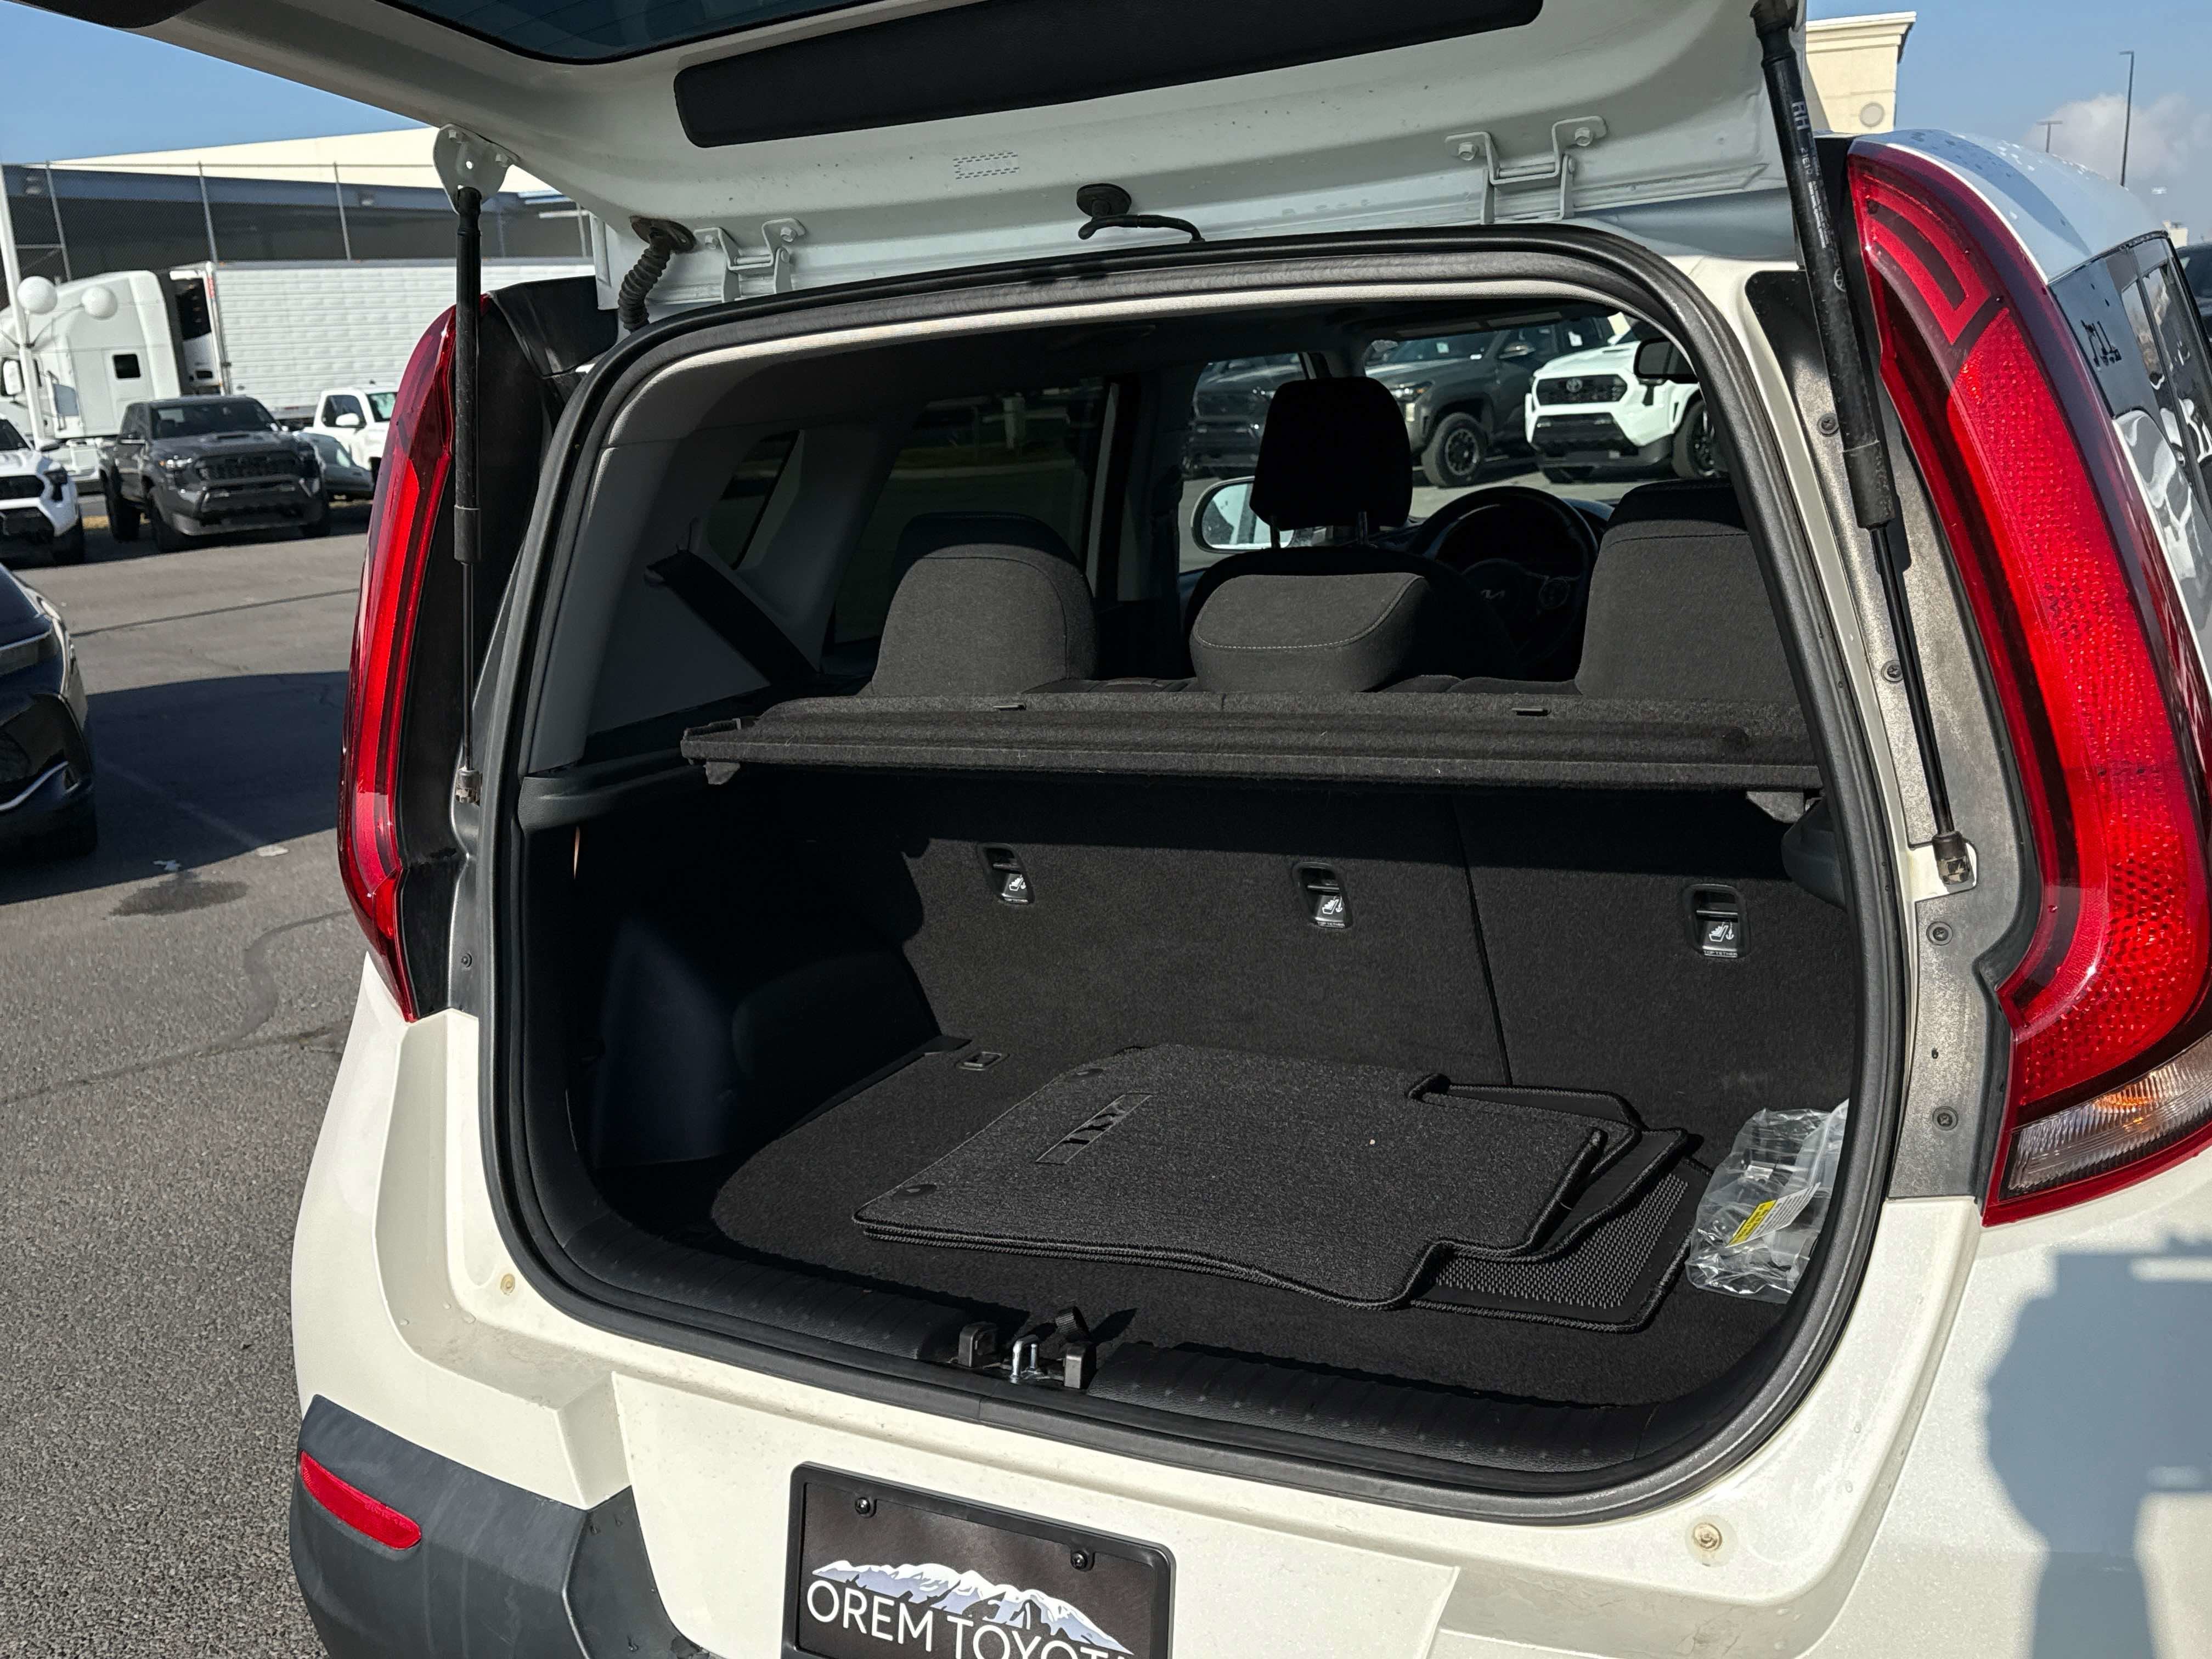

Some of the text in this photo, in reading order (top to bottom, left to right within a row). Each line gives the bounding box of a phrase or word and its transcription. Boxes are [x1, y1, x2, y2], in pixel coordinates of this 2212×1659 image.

[1792, 101, 1810, 131] RH
[807, 1580, 1125, 1659] OREM TOY
